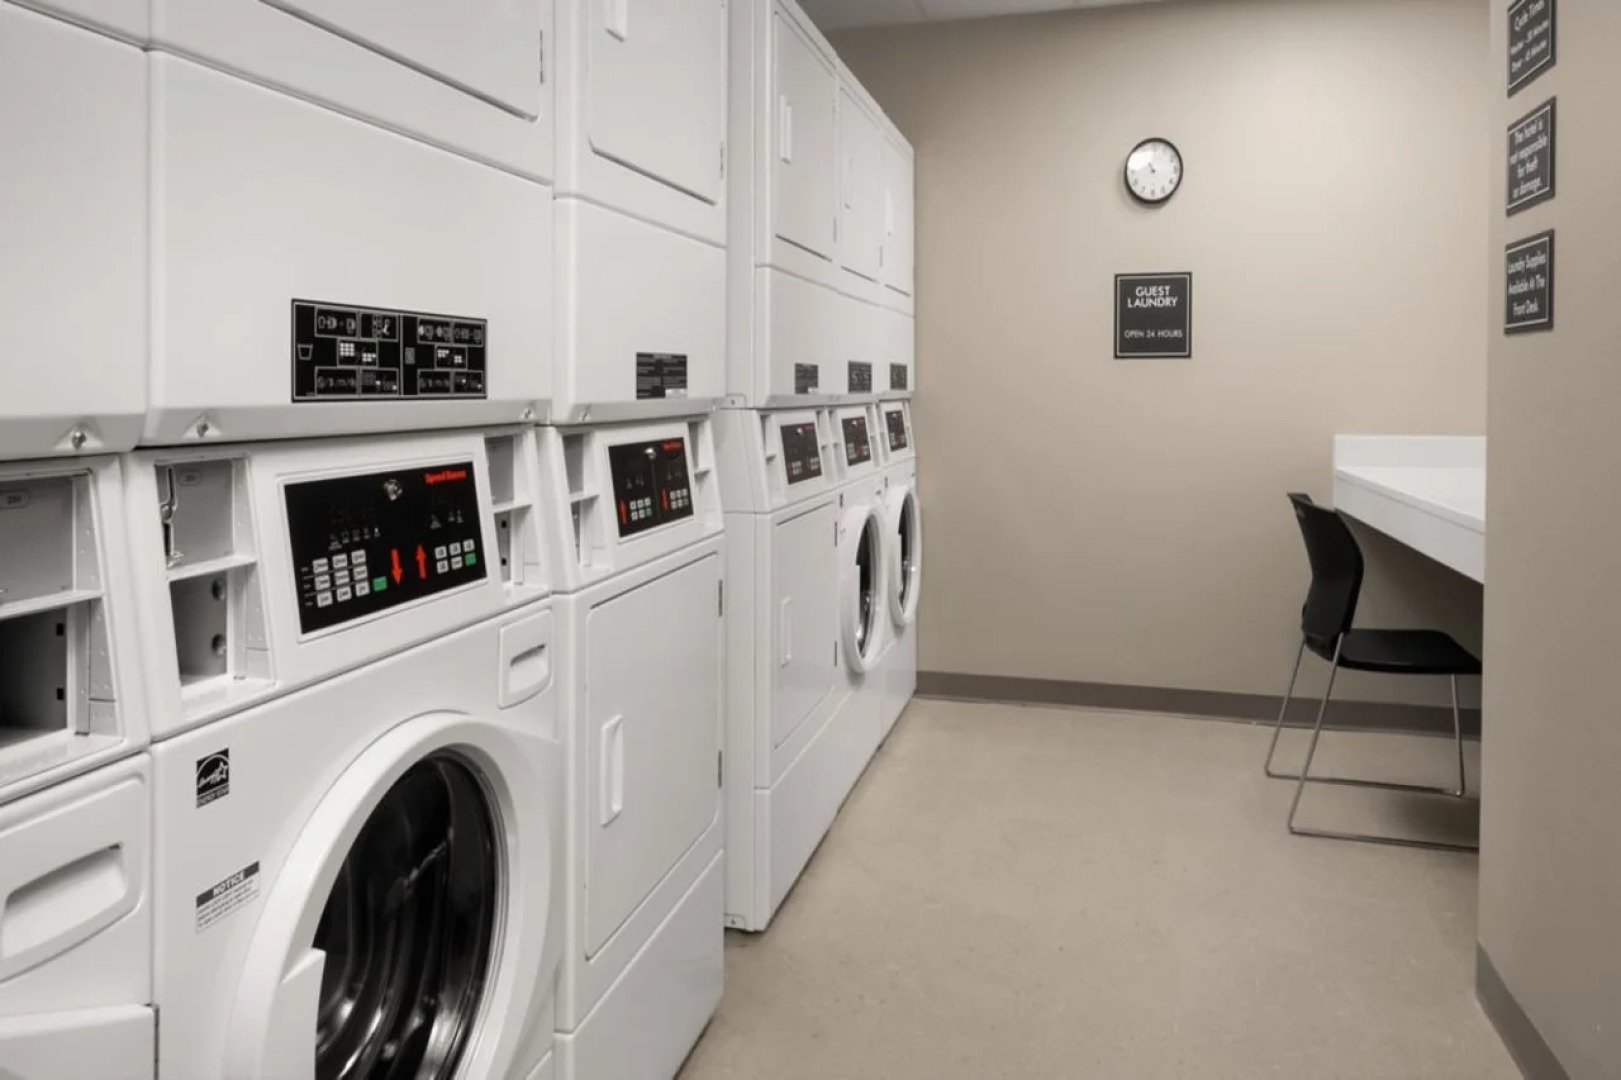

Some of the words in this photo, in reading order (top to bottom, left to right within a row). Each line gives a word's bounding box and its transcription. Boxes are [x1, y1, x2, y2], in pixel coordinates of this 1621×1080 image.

[1135, 286, 1171, 297] GUEST
[1127, 297, 1179, 308] LAUNDRY
[1124, 329, 1144, 339] OPEN
[1146, 329, 1155, 338] 24
[1157, 329, 1183, 338] HOURS
[212, 870, 245, 897] NOTICE
